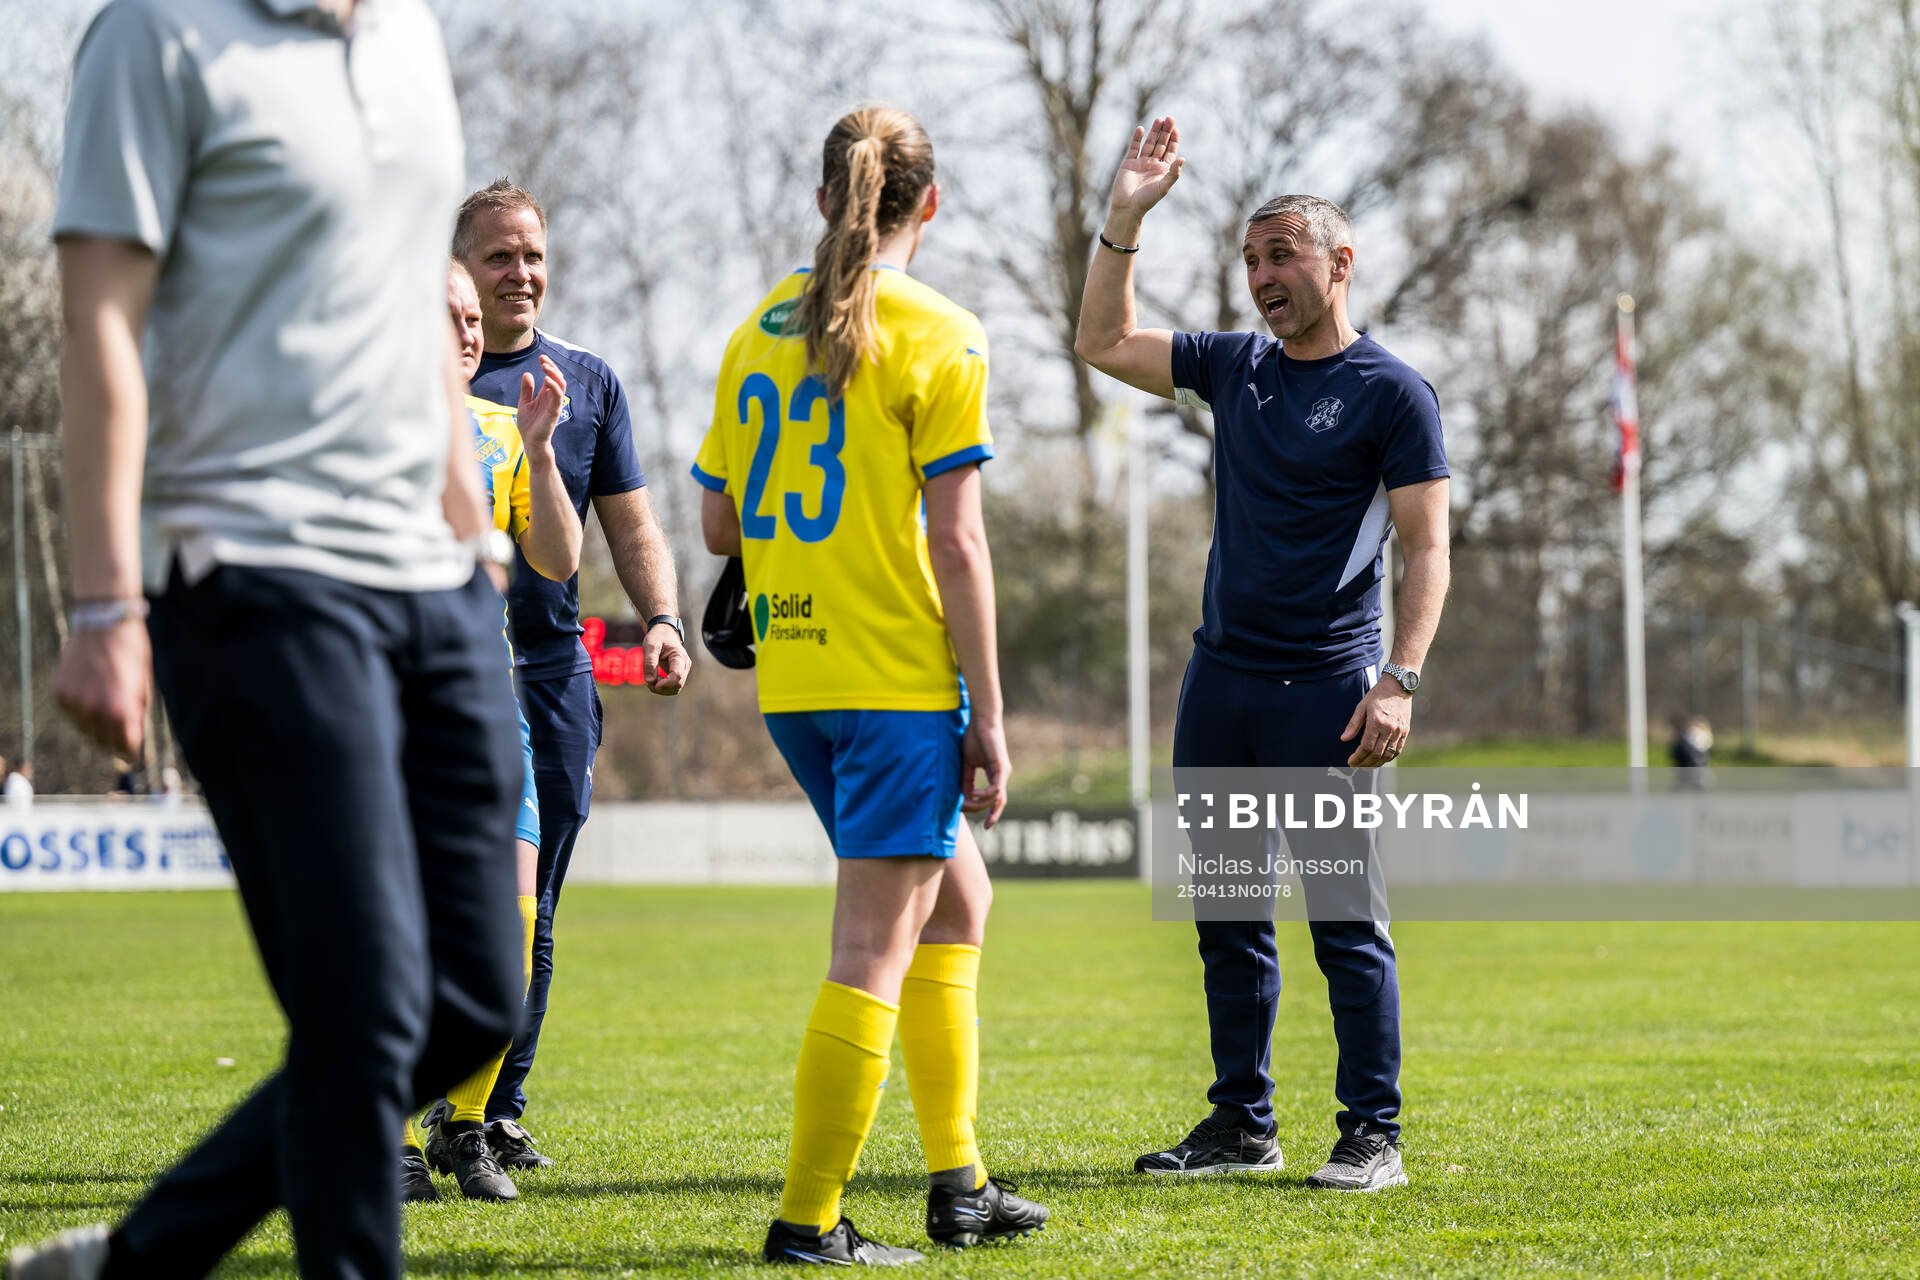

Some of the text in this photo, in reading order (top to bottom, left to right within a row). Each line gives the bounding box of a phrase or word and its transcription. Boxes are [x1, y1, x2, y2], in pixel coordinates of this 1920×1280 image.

[737, 372, 846, 543] 23
[771, 593, 812, 619] Solid
[770, 624, 827, 646] Försäkring
